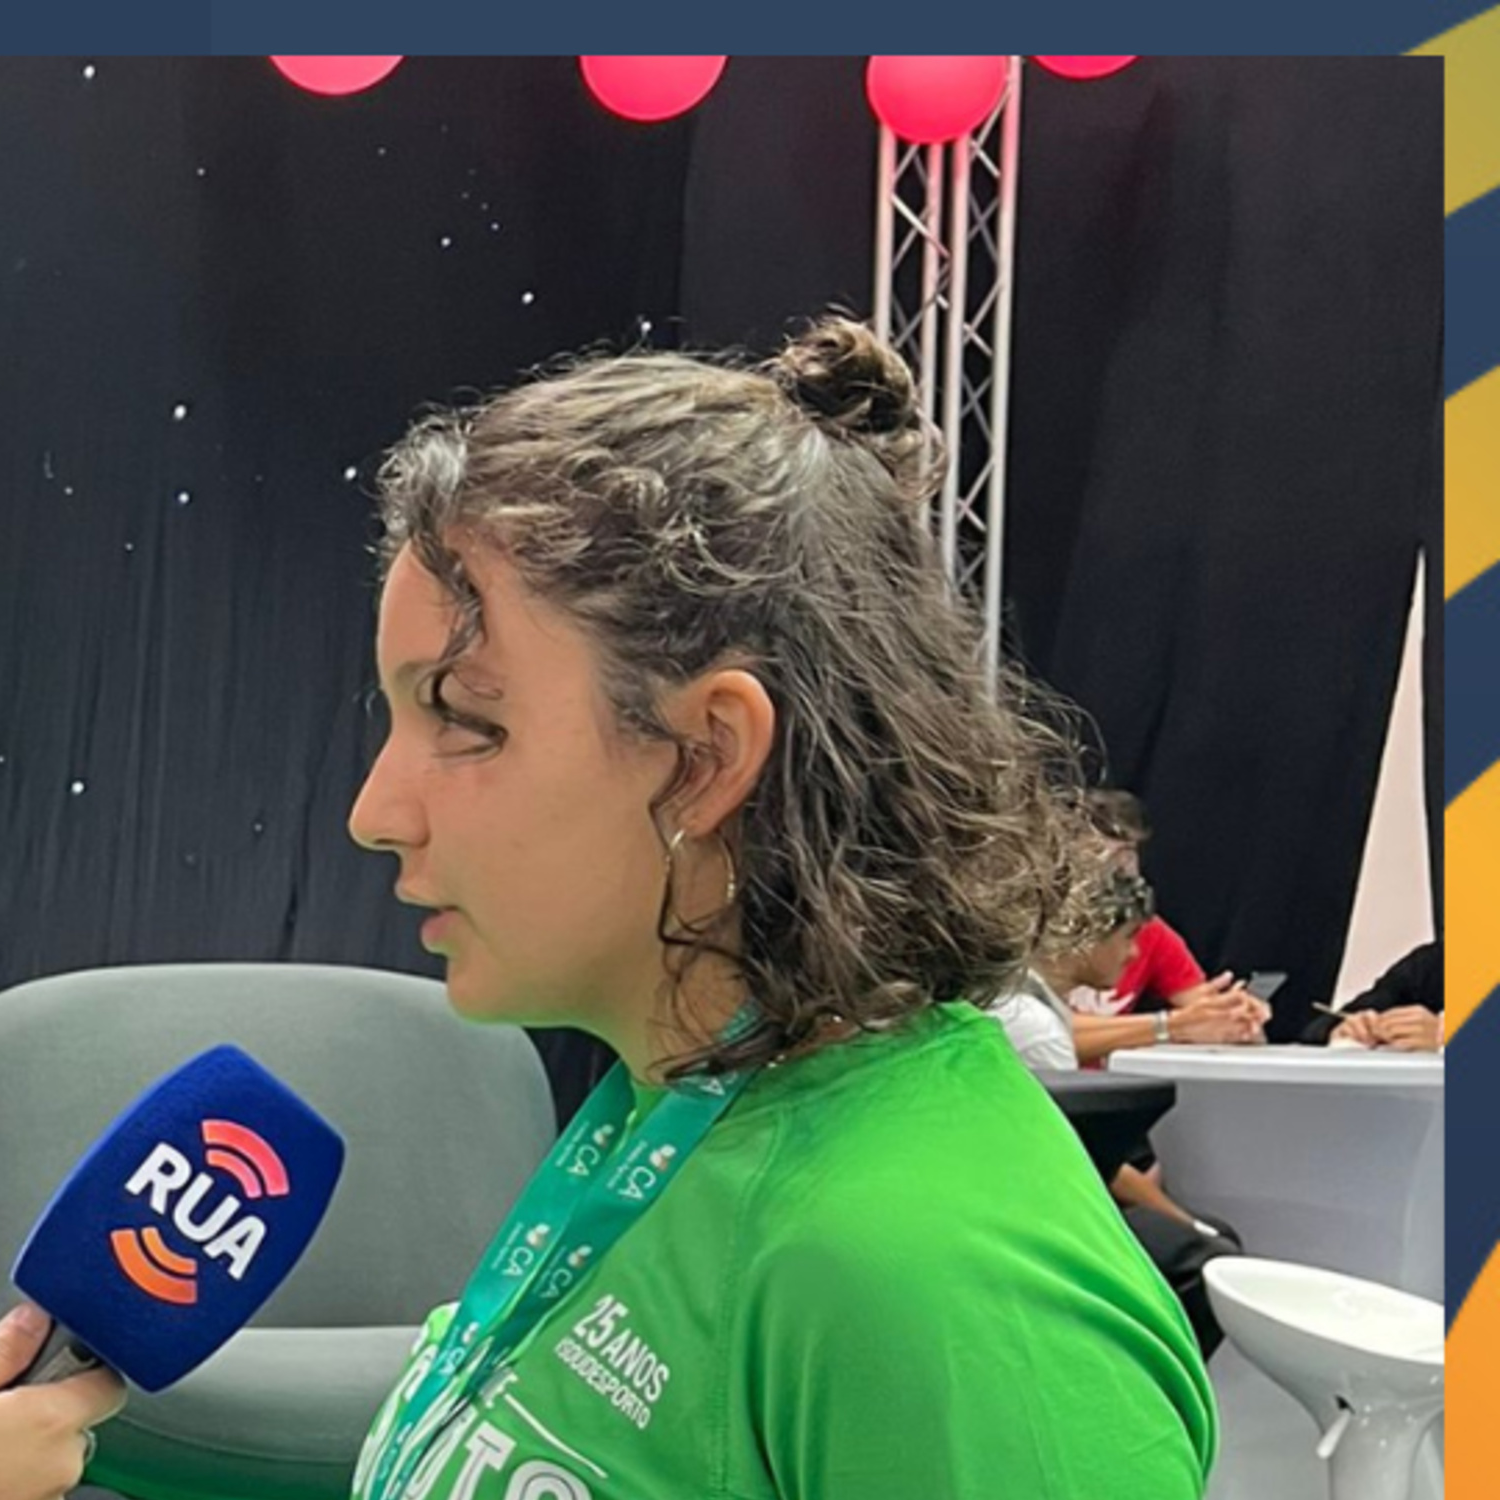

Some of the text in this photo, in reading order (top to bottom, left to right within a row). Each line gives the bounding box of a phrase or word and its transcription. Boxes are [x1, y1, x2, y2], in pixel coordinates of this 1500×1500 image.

[124, 1141, 267, 1280] RUA
[618, 1166, 656, 1200] CA
[502, 1246, 534, 1276] CA
[573, 1294, 671, 1403] 25 ANOS
